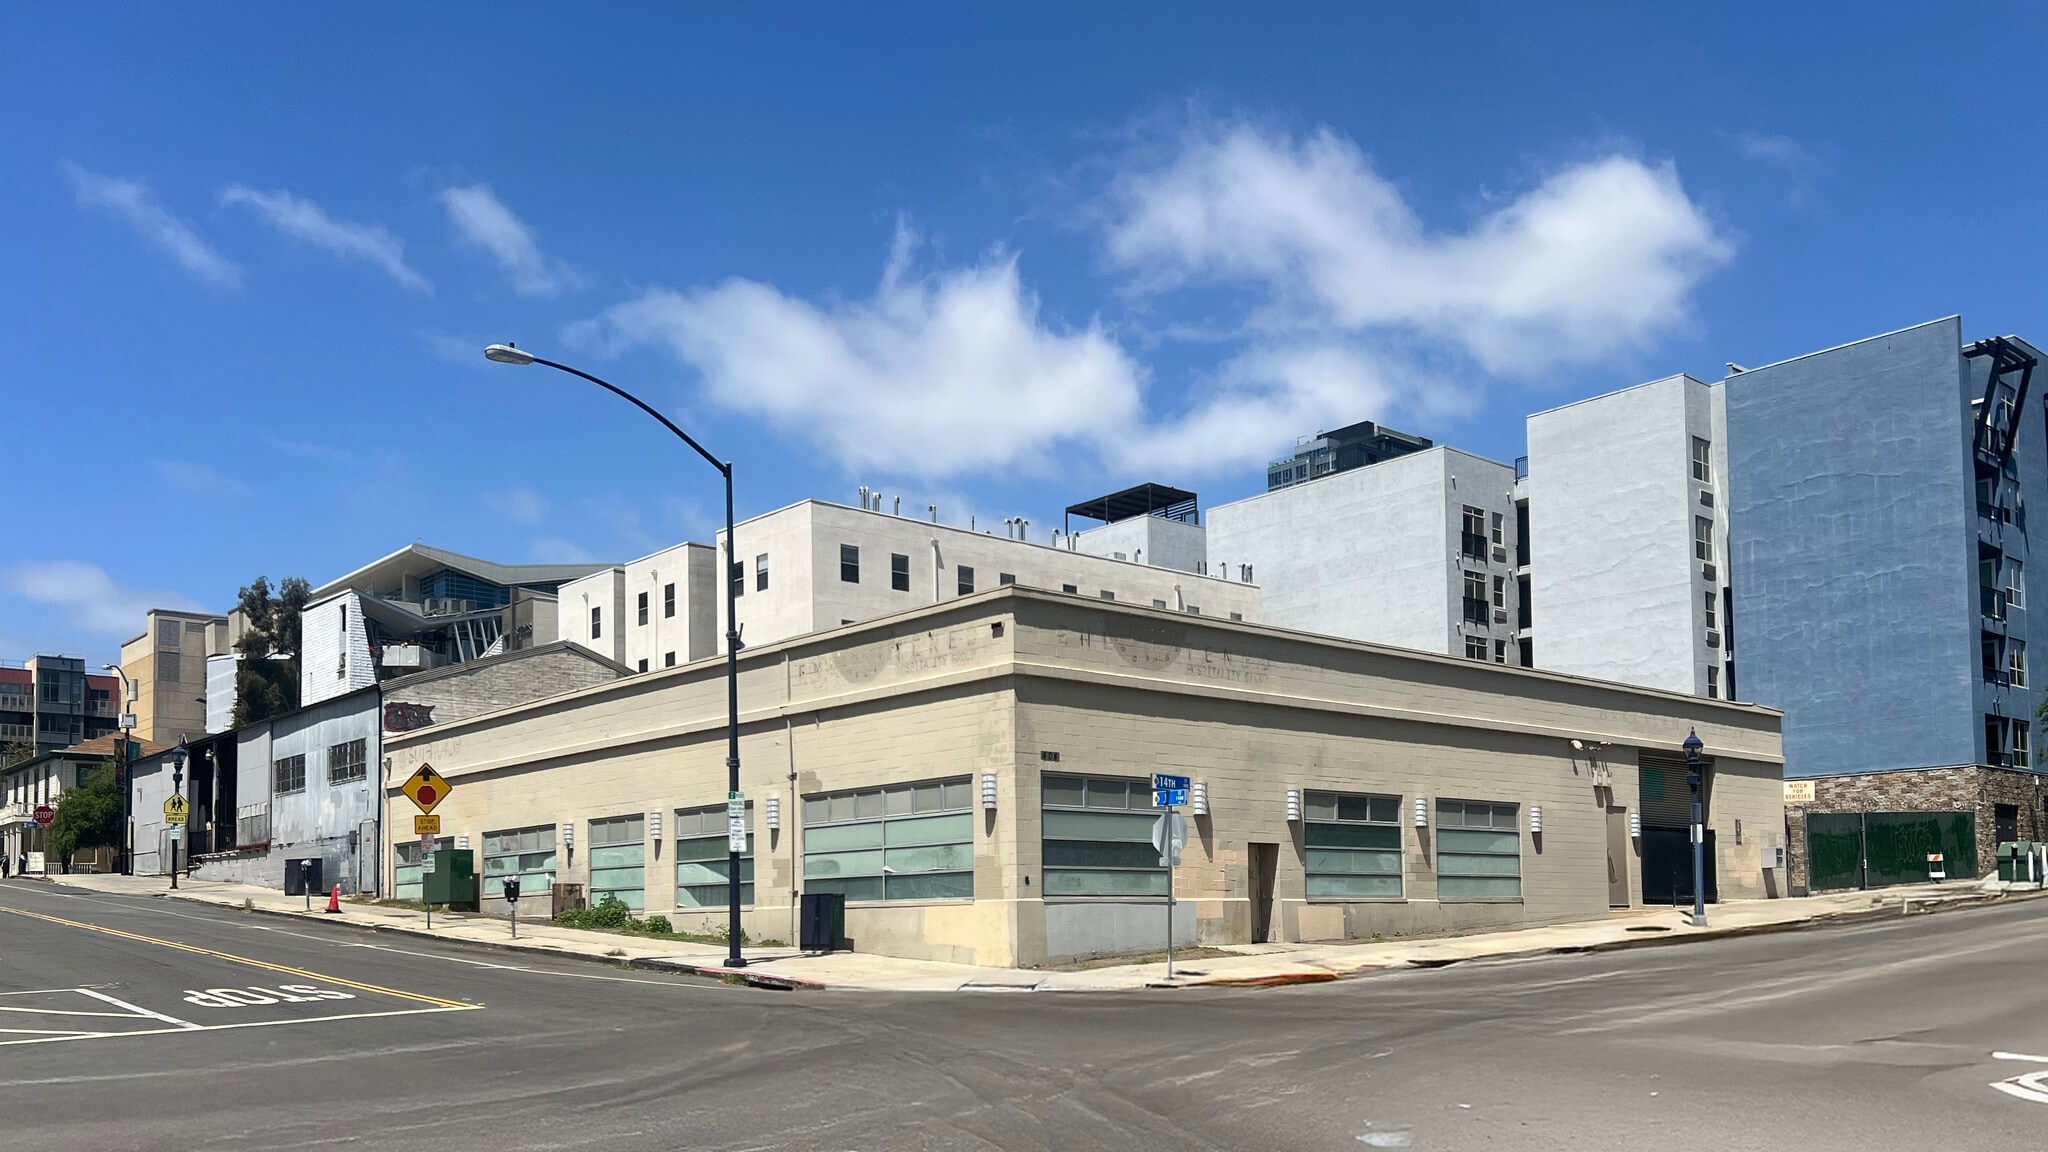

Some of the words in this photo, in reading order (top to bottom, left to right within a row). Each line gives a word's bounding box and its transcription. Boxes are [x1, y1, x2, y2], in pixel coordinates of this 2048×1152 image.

[1160, 776, 1176, 788] 14TH
[34, 811, 53, 819] STOP
[183, 984, 356, 1007] STOP
